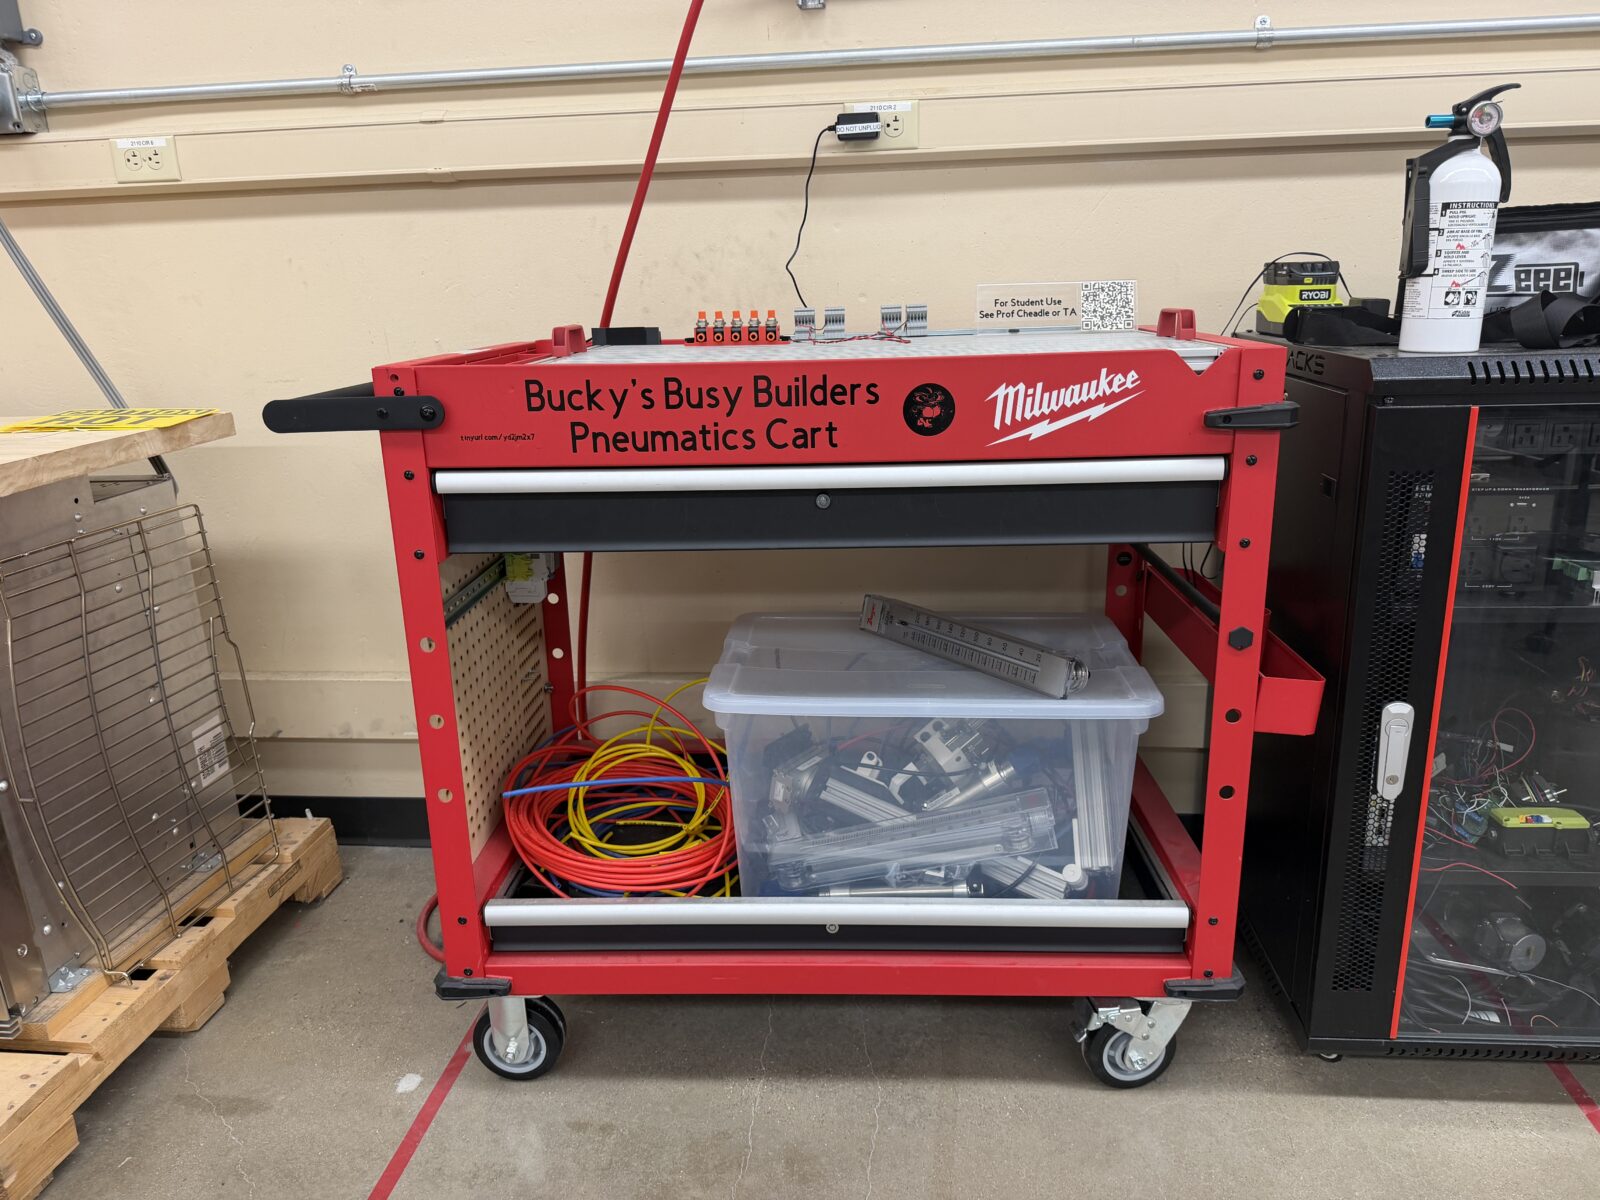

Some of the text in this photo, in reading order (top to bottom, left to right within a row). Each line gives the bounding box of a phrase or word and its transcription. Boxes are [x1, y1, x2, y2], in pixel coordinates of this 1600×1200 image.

[1302, 291, 1329, 299] RYOBI
[994, 298, 1062, 307] For Student Use
[980, 310, 994, 318] See
[996, 310, 1015, 318] Prof
[1016, 309, 1050, 318] Cheadle
[1063, 308, 1077, 316] TA
[524, 374, 880, 419] Bucky's Busy Builders
[984, 368, 1140, 430] Milwaukee
[31, 416, 174, 425] HOT
[570, 418, 838, 453] Pneumatics Cart
